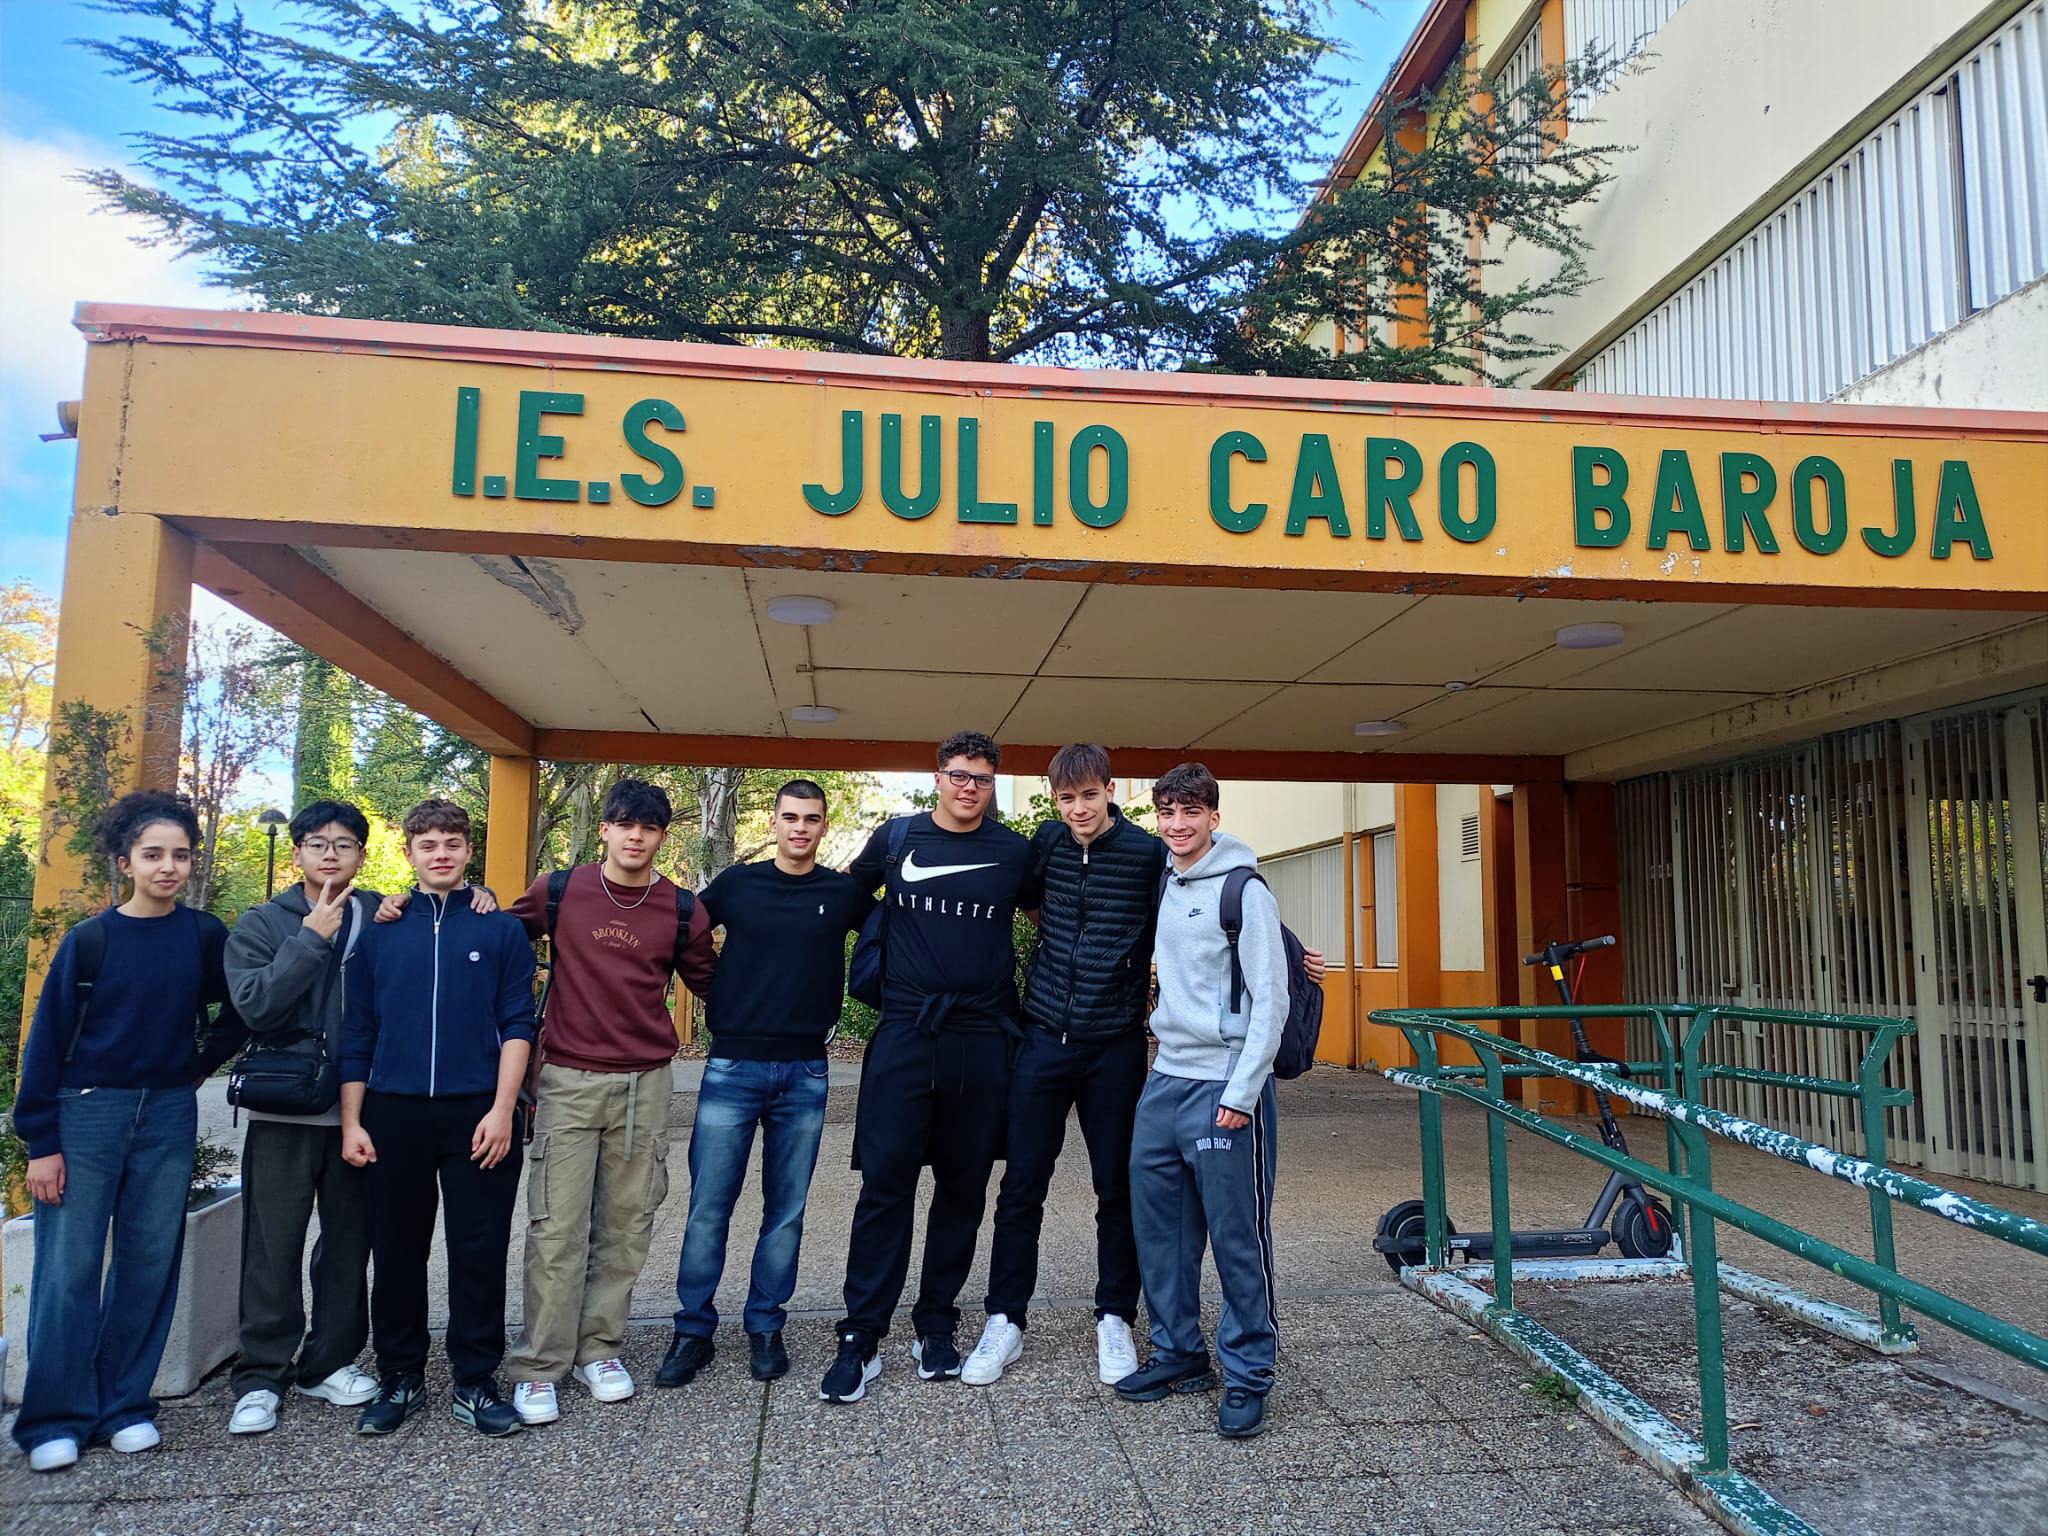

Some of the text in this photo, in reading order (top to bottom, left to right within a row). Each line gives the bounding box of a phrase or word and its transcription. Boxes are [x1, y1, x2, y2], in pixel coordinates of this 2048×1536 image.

[452, 386, 1995, 560] I.E.S. JULIO CARO BAROJA
[591, 927, 641, 948] BROOKLYN
[1213, 1136, 1232, 1151] RICH
